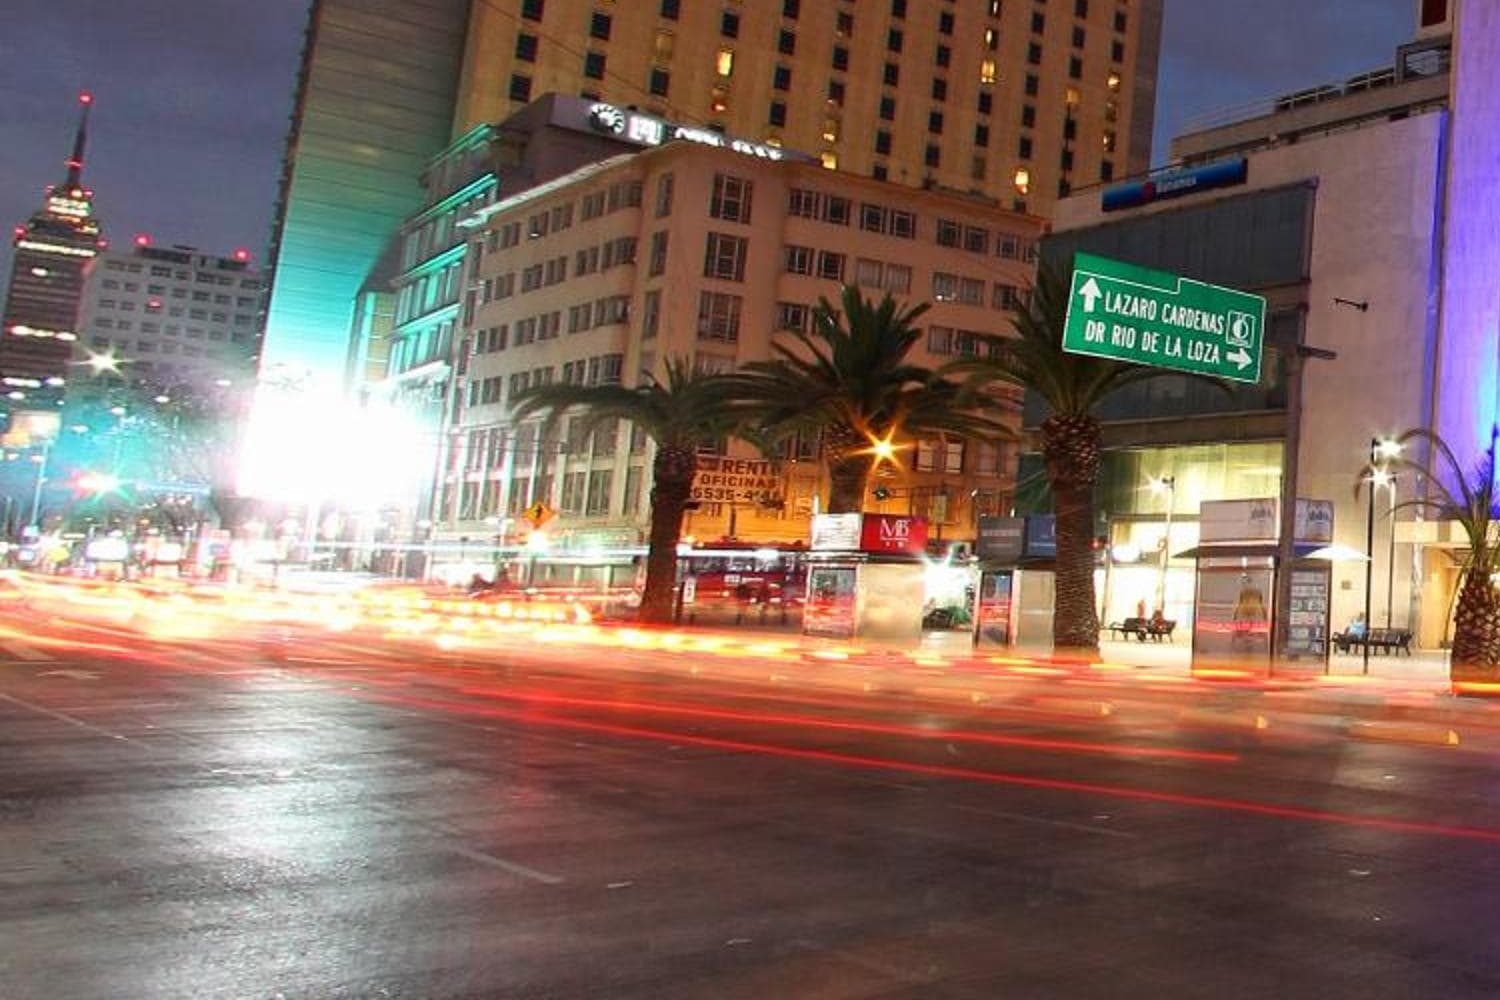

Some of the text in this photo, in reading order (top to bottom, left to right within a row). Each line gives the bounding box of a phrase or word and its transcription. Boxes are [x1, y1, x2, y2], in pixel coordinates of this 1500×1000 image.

[1104, 291, 1225, 335] LAZARO CARDENAS
[1084, 320, 1106, 344] DR
[1111, 325, 1136, 349] RIO
[1141, 332, 1158, 353] DE
[1164, 336, 1182, 358] LA
[1187, 340, 1220, 364] LOZA
[701, 473, 777, 489] OFICINAS
